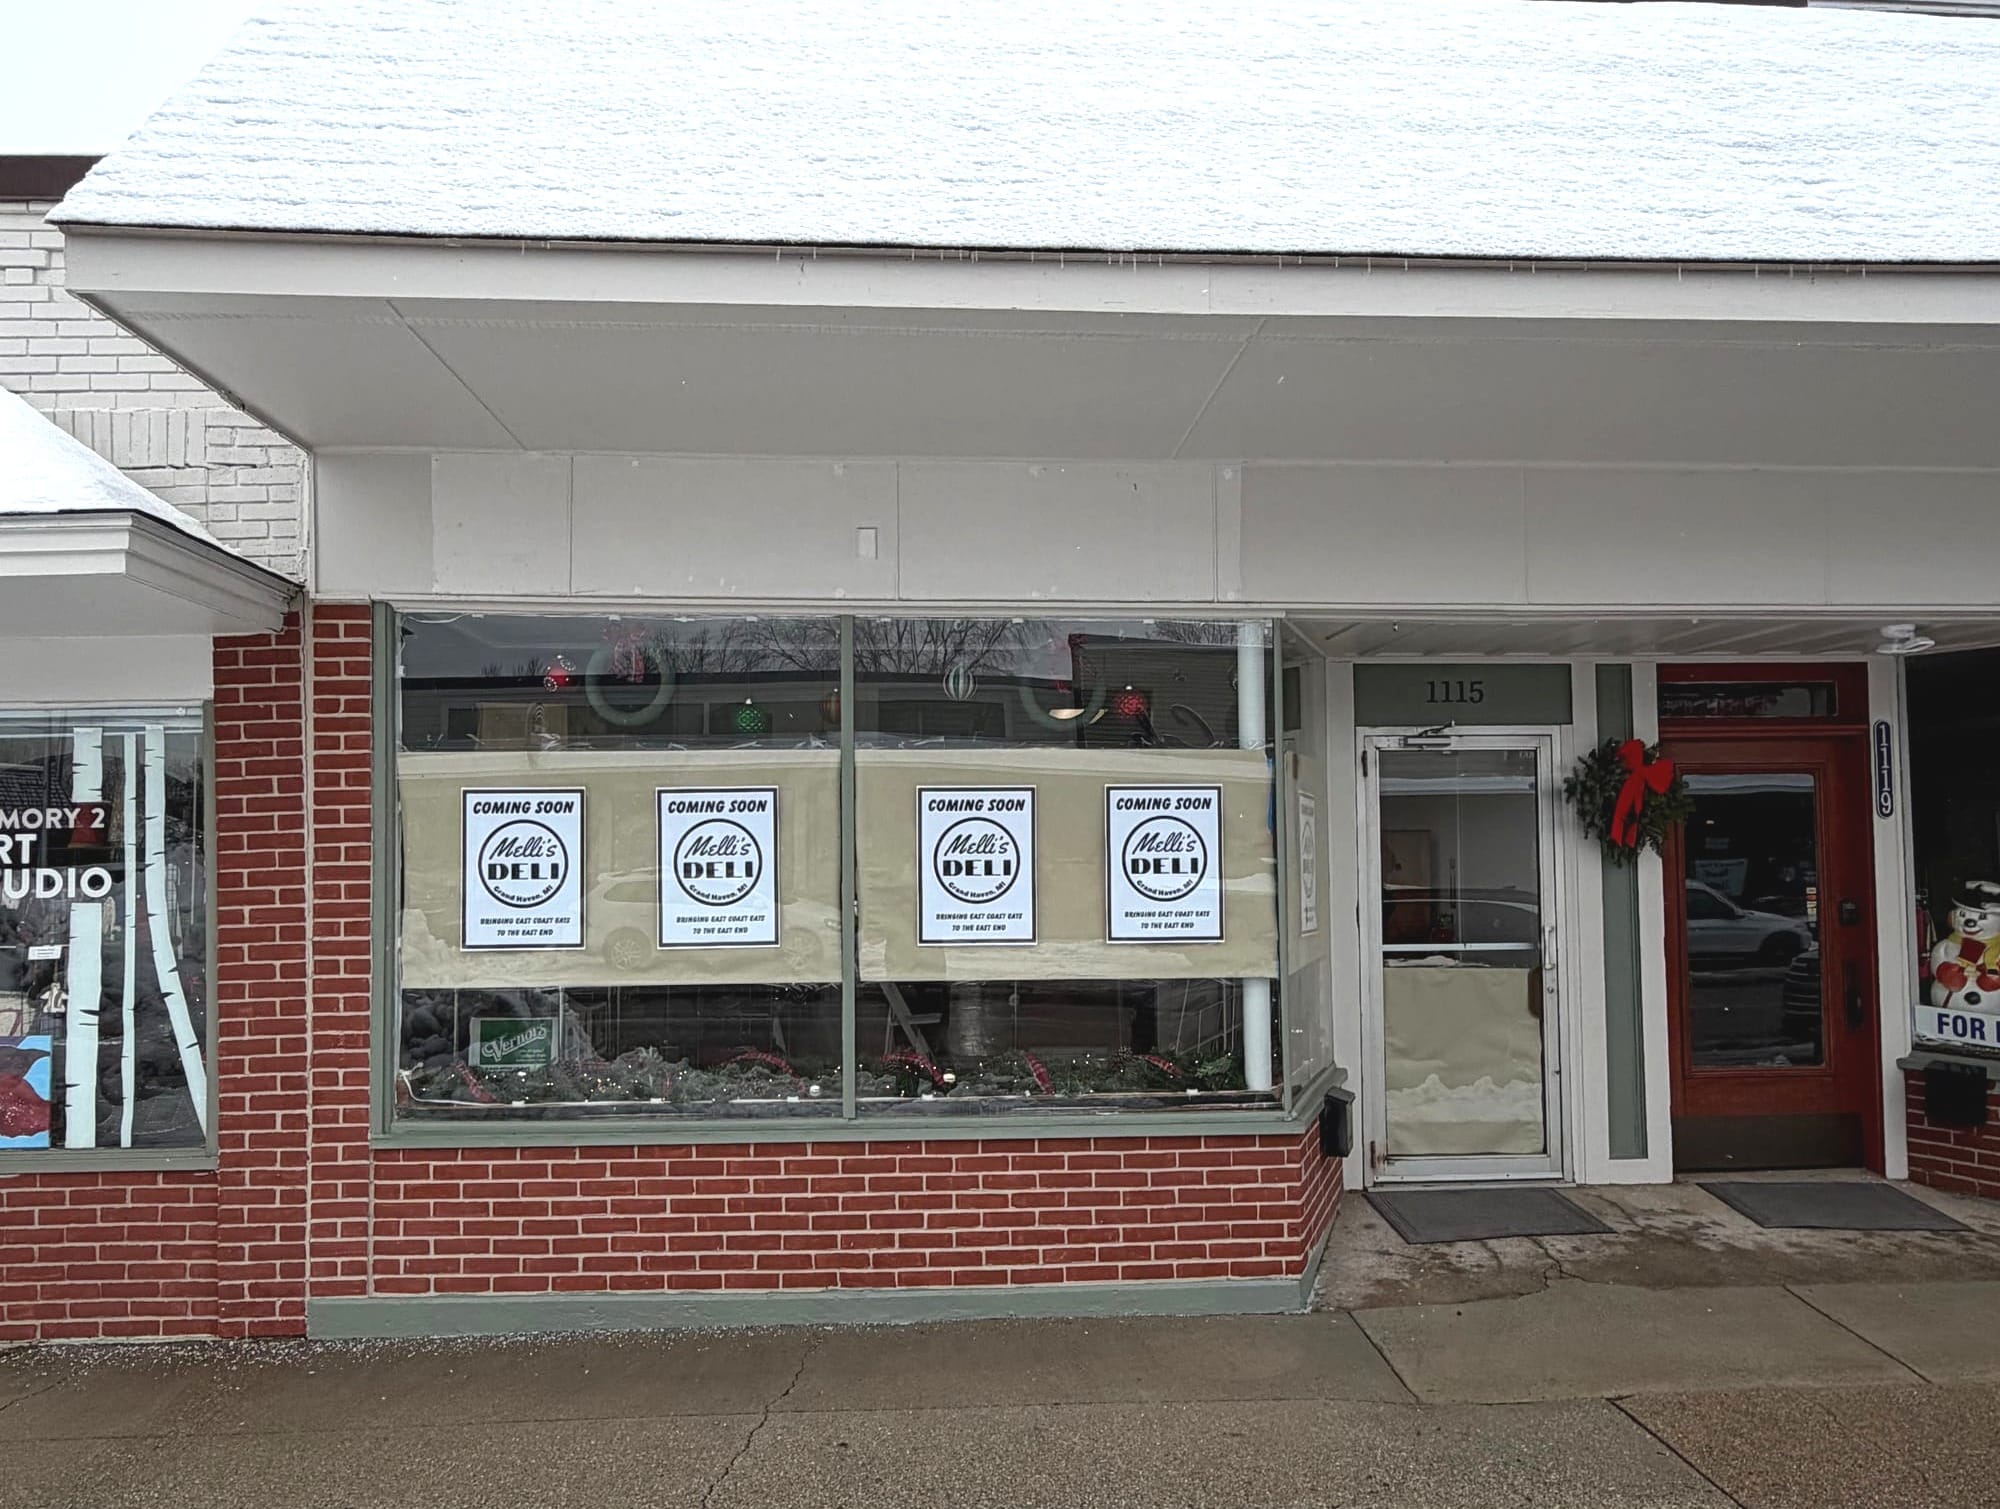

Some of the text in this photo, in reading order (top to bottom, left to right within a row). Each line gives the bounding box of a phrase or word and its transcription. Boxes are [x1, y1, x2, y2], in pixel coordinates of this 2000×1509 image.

[1426, 680, 1484, 704] 1115
[1879, 724, 1892, 814] 1119
[473, 801, 574, 814] COMING SOON
[668, 800, 767, 813] COMING SOON
[928, 800, 1025, 812] COMING SOON
[1117, 798, 1212, 810] COMING SOON
[90, 808, 105, 829] 2
[489, 837, 557, 860] Melli's
[684, 835, 751, 859] Melli's
[944, 834, 1010, 856] Melli's
[1132, 832, 1197, 855] Melli's
[488, 863, 559, 880] DELI
[683, 861, 753, 878] DELI
[943, 860, 1011, 876] DELI
[1131, 858, 1199, 874] DELI
[494, 886, 515, 901] Grand
[689, 885, 710, 899] Grand
[948, 882, 969, 897] Grand
[1137, 880, 1157, 895] Grand
[1937, 1012, 1986, 1041] FOR
